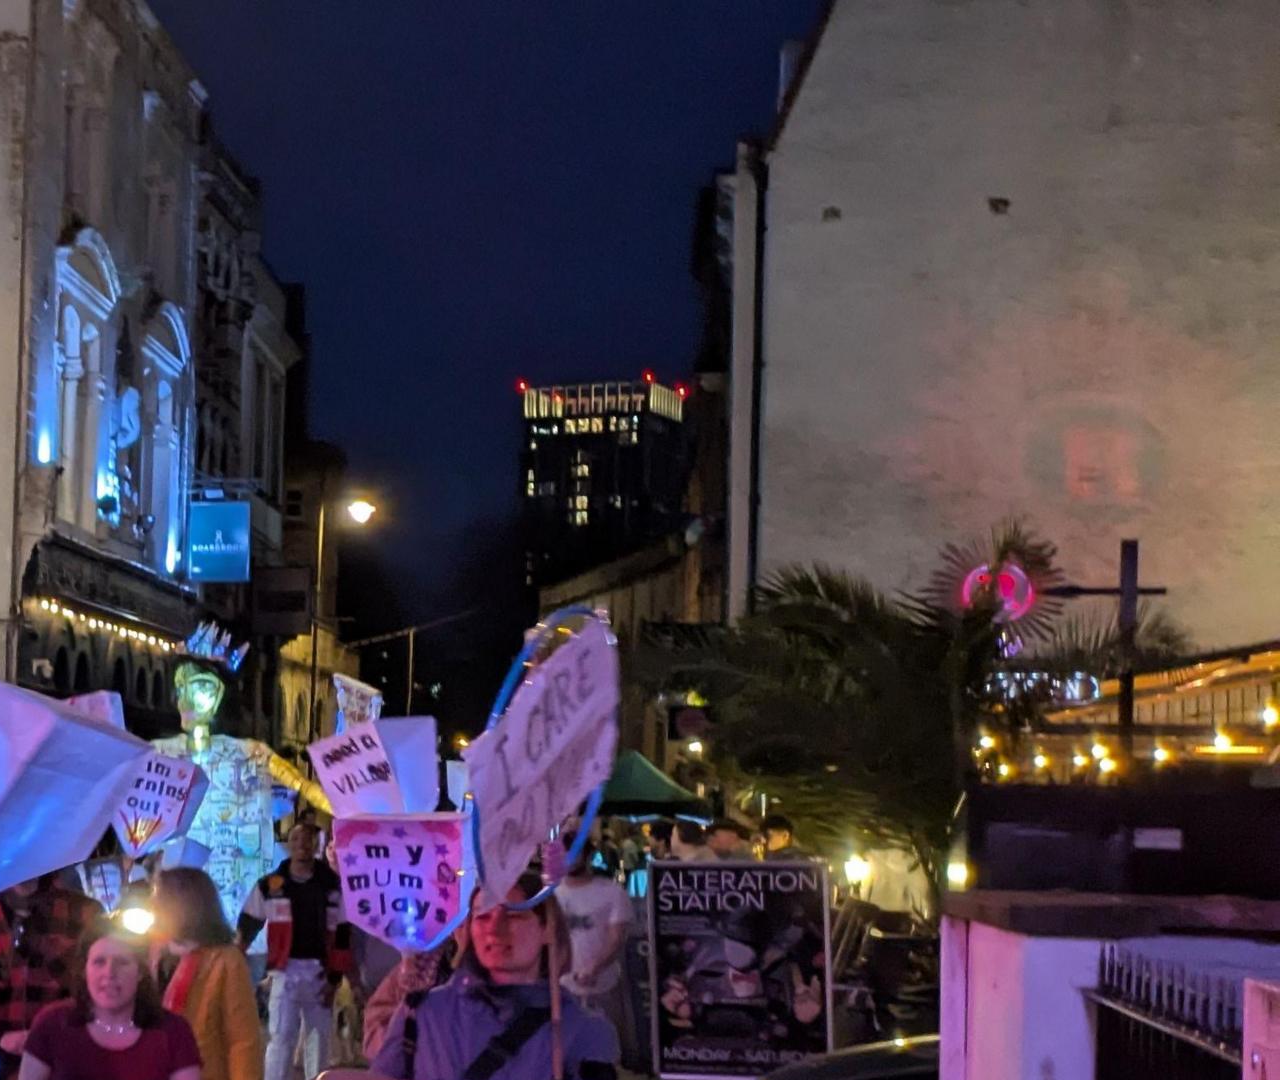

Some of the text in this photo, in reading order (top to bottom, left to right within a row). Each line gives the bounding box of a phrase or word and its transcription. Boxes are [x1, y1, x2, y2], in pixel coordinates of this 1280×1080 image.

[527, 650, 594, 763] CARE
[365, 844, 423, 865] my
[658, 871, 818, 892] ALTERATION
[357, 893, 449, 923] slays
[659, 891, 765, 911] STATION
[663, 1047, 731, 1061] MONDAY
